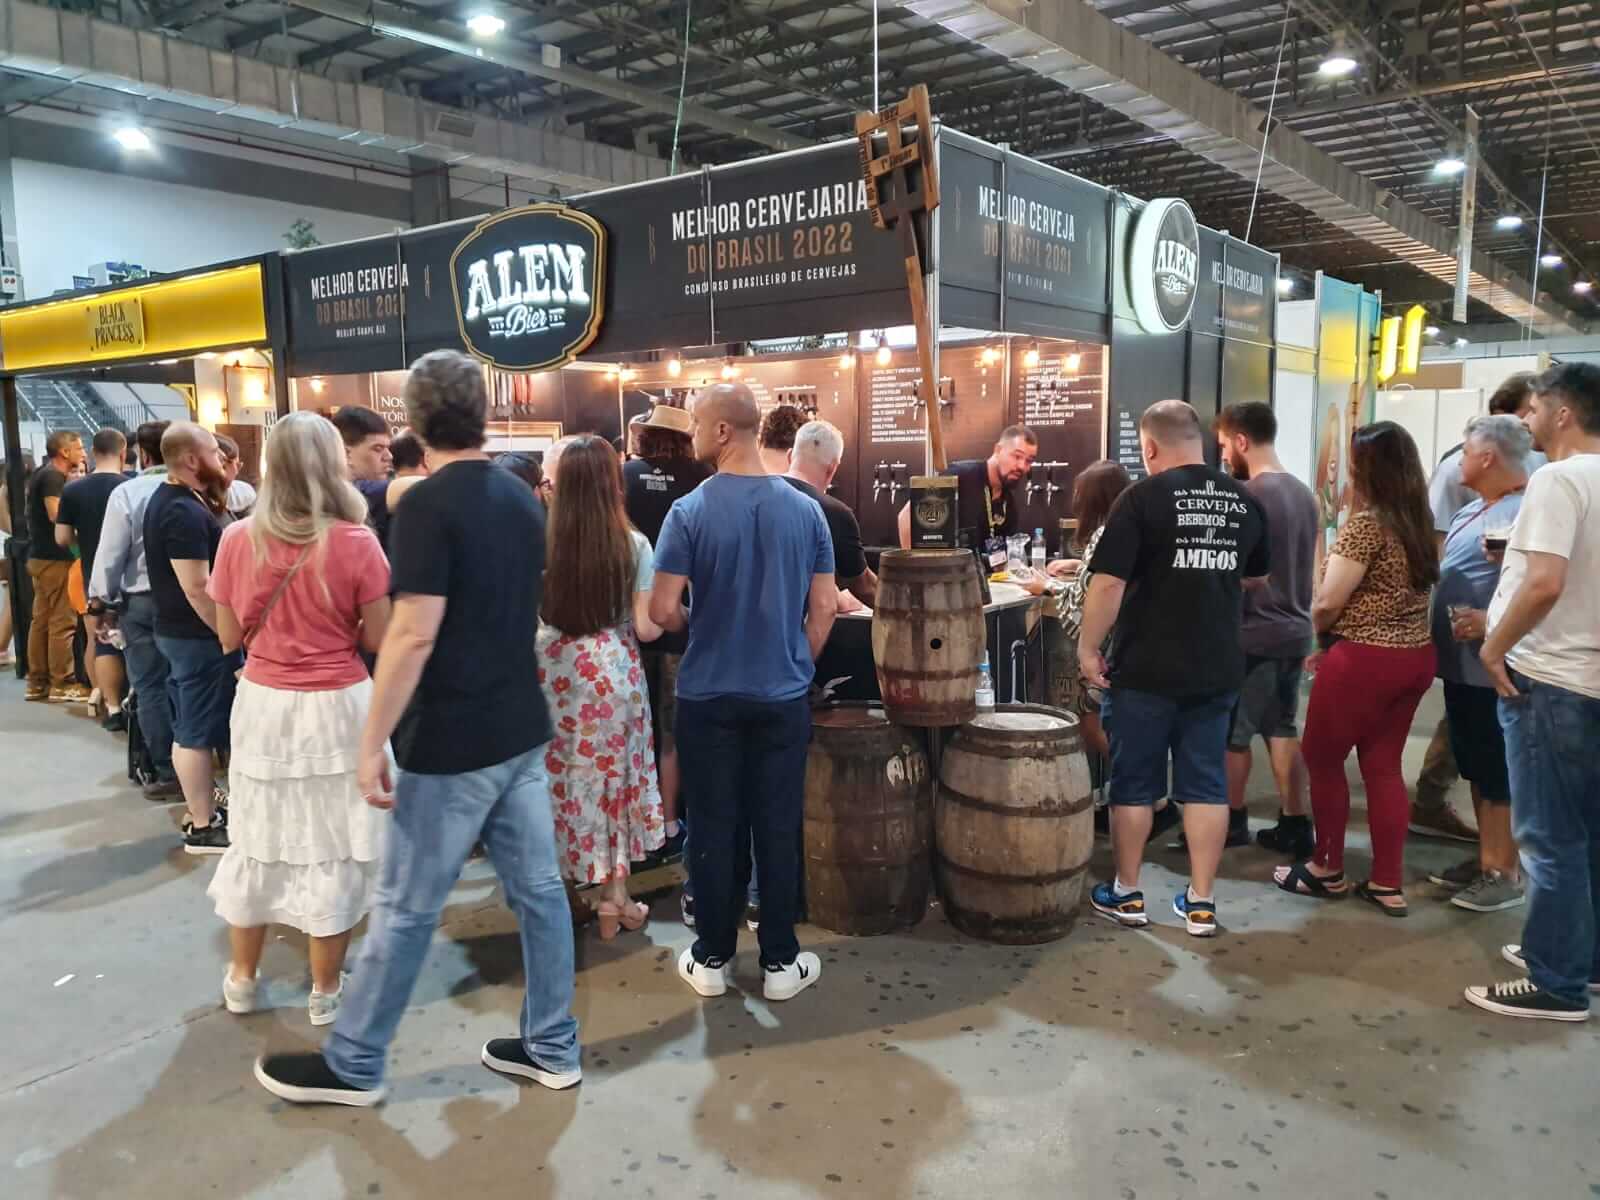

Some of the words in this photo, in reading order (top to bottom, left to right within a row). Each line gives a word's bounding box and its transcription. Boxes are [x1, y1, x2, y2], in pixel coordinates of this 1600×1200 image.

[672, 202, 740, 241] MELHOR
[746, 179, 869, 230] CERVEJARIA
[1029, 200, 1076, 242] CERVEJA
[687, 243, 706, 274] DO
[716, 231, 785, 270] BRASIL
[792, 221, 853, 260] 2022
[1007, 229, 1041, 268] RASIL
[311, 271, 355, 300] MELHOR
[466, 243, 590, 320] ALEM
[732, 270, 787, 290] BRASILEIRO
[791, 269, 802, 282] DE
[806, 263, 857, 280] CERVEJAS
[1211, 259, 1233, 288] MELOR
[333, 297, 371, 323] BRASIL
[504, 304, 549, 337] Bier
[95, 322, 135, 349] PRINCESS
[1175, 498, 1247, 514] CERVEJAS
[1177, 513, 1226, 527] BEBEMOS
[1172, 548, 1239, 570] AMIGOS
